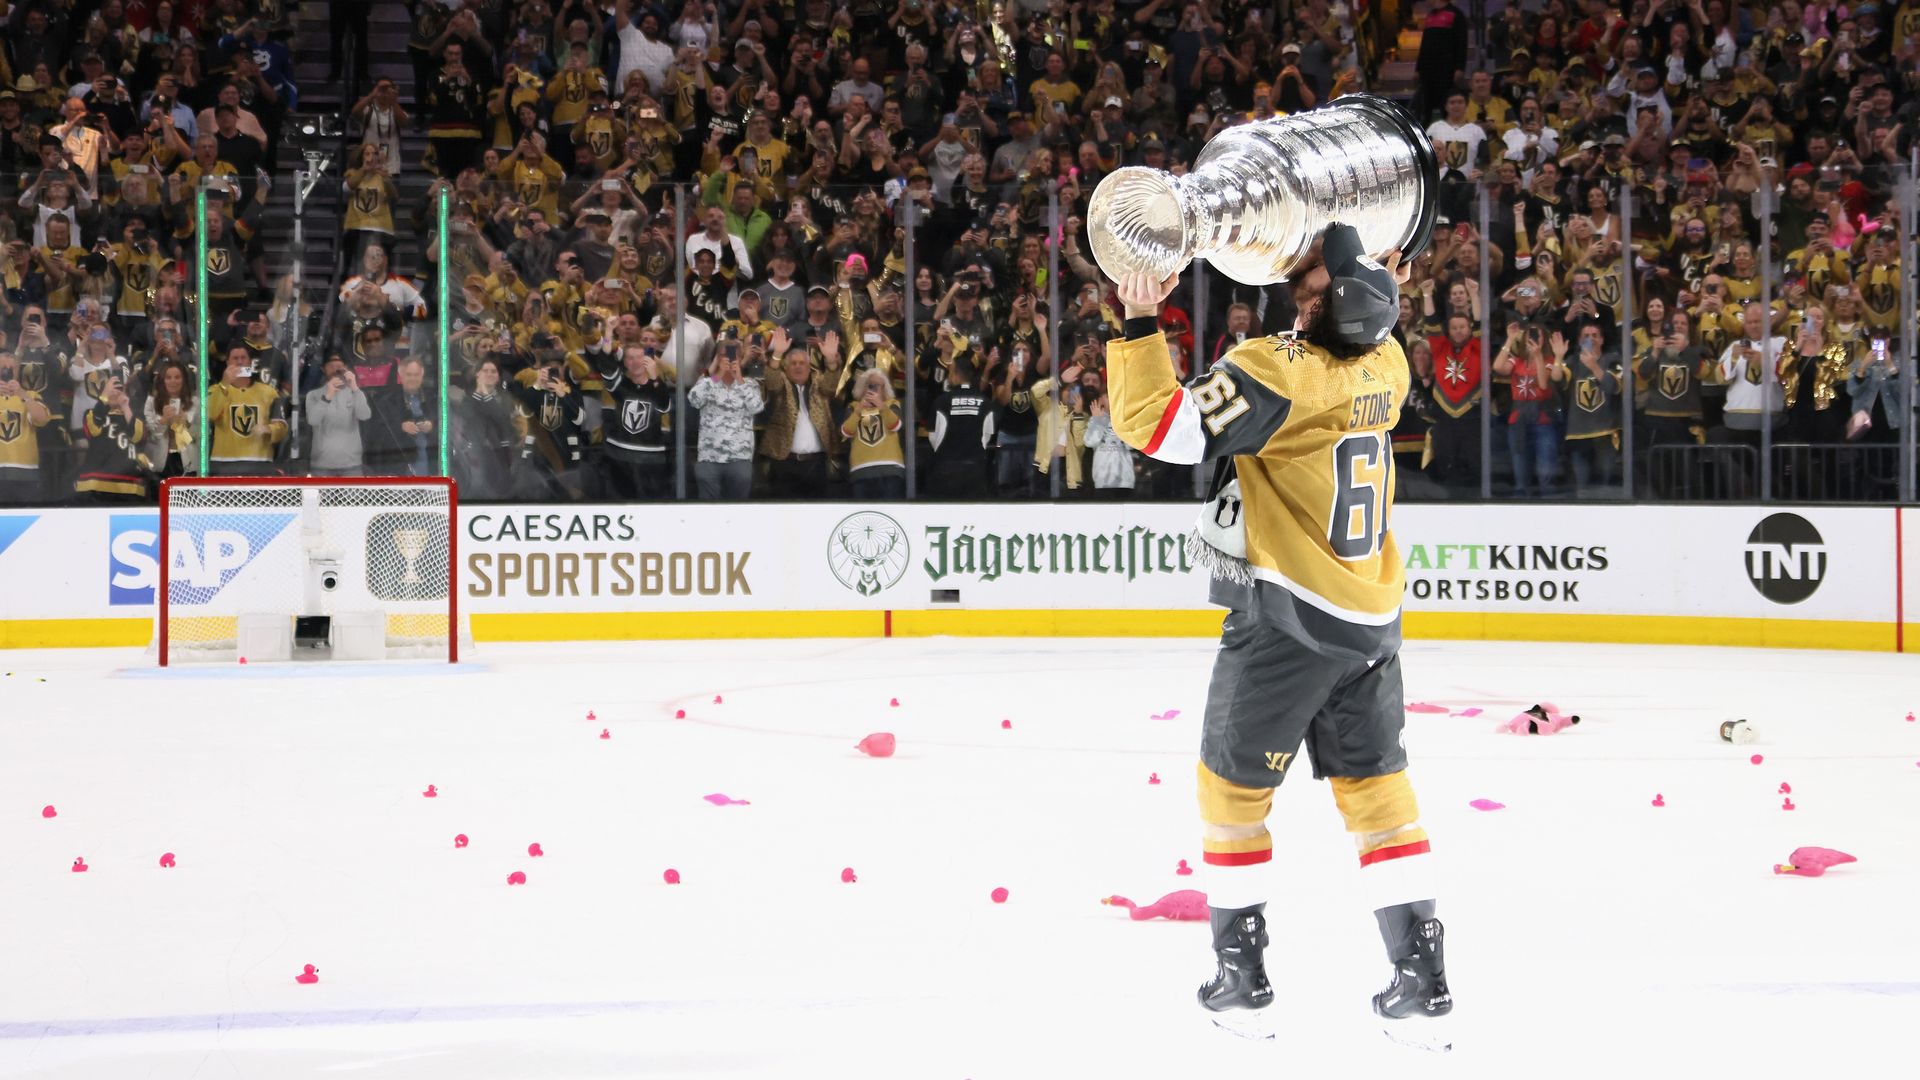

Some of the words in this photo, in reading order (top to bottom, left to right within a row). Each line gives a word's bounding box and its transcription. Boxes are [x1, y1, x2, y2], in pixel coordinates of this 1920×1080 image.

[951, 397, 984, 406] BEST
[1191, 370, 1251, 437] 61
[1350, 390, 1392, 429] STONE
[1326, 431, 1392, 561] 61
[468, 514, 636, 542] CAESARS
[111, 529, 250, 590] SAP
[468, 551, 752, 597] SPORTSBOOK
[1405, 543, 1609, 572] AFTKINGS
[1744, 543, 1827, 581] TNT
